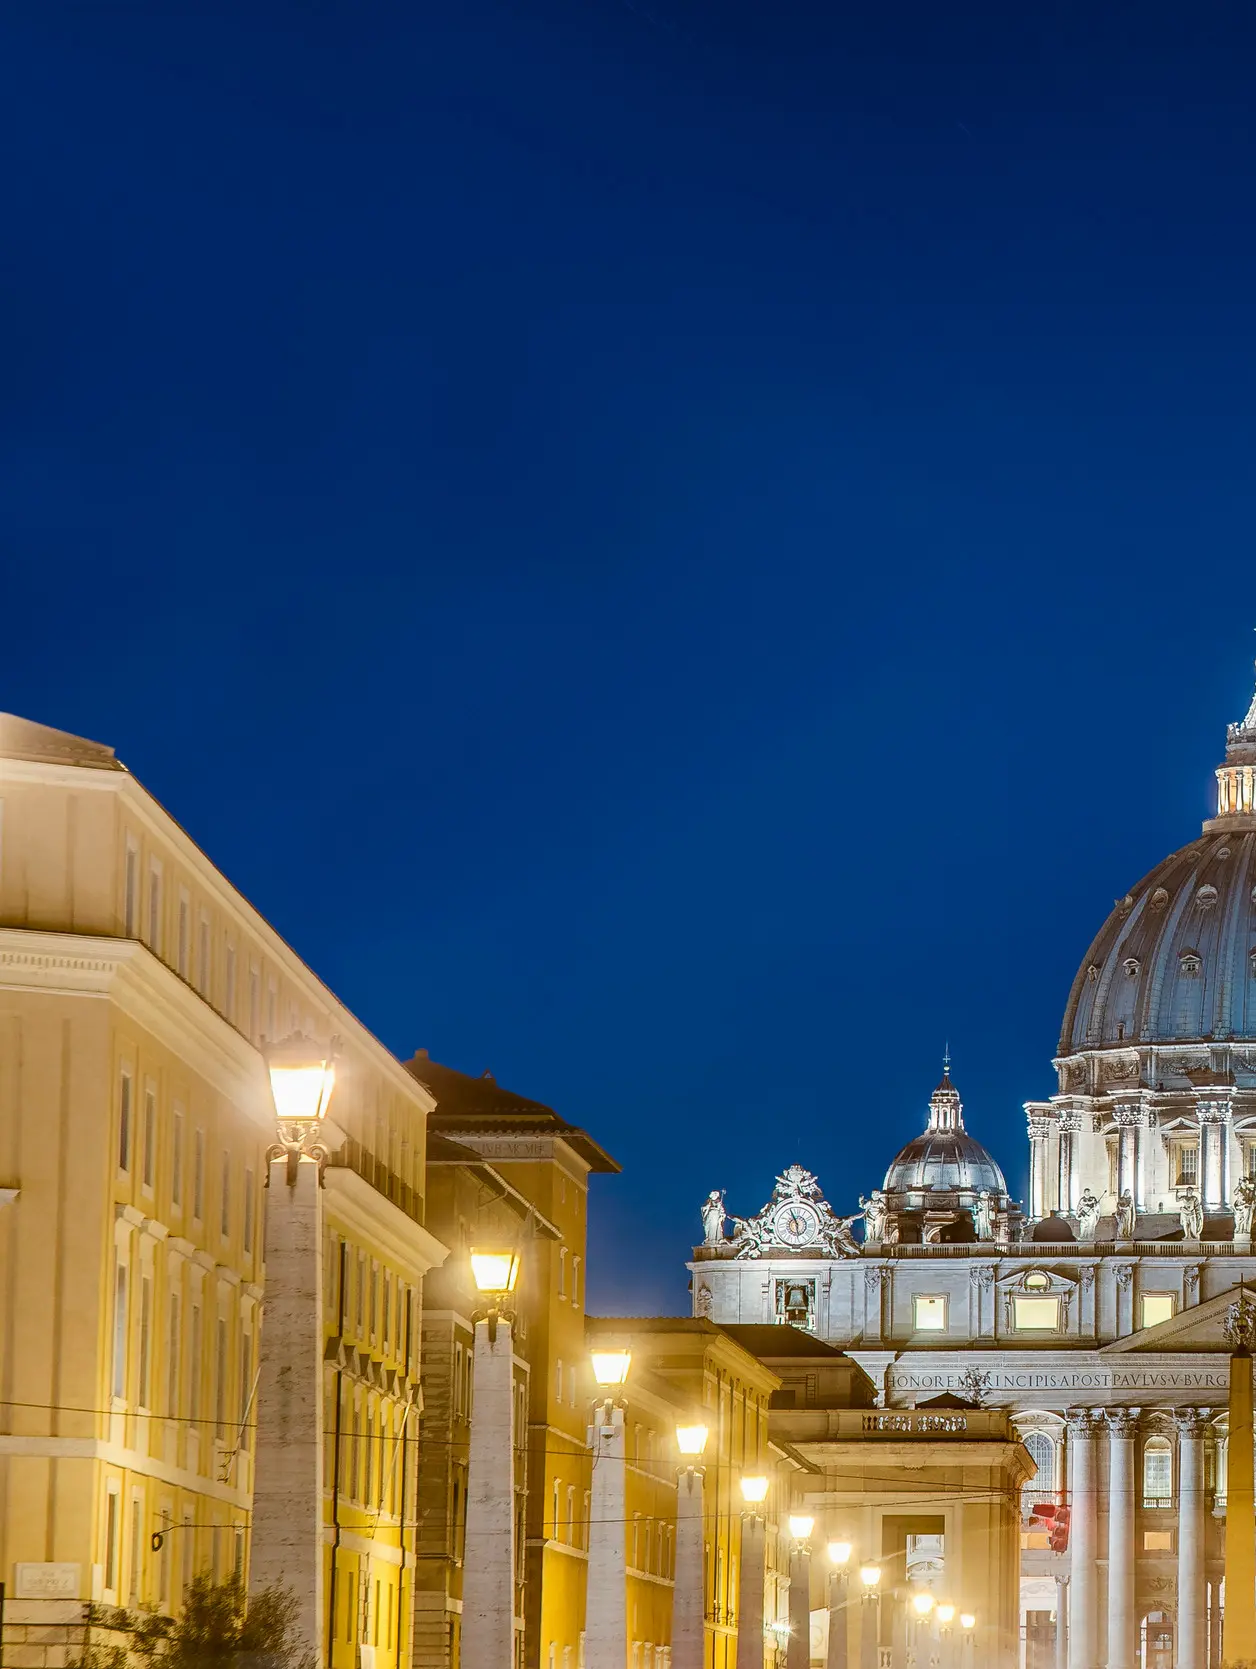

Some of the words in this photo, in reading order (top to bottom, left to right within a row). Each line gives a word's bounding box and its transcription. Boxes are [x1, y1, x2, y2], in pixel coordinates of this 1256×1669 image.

[974, 1375, 1057, 1388] RINCIPIS
[1060, 1374, 1111, 1387] APOST
[1112, 1374, 1167, 1387] PAVLVS
